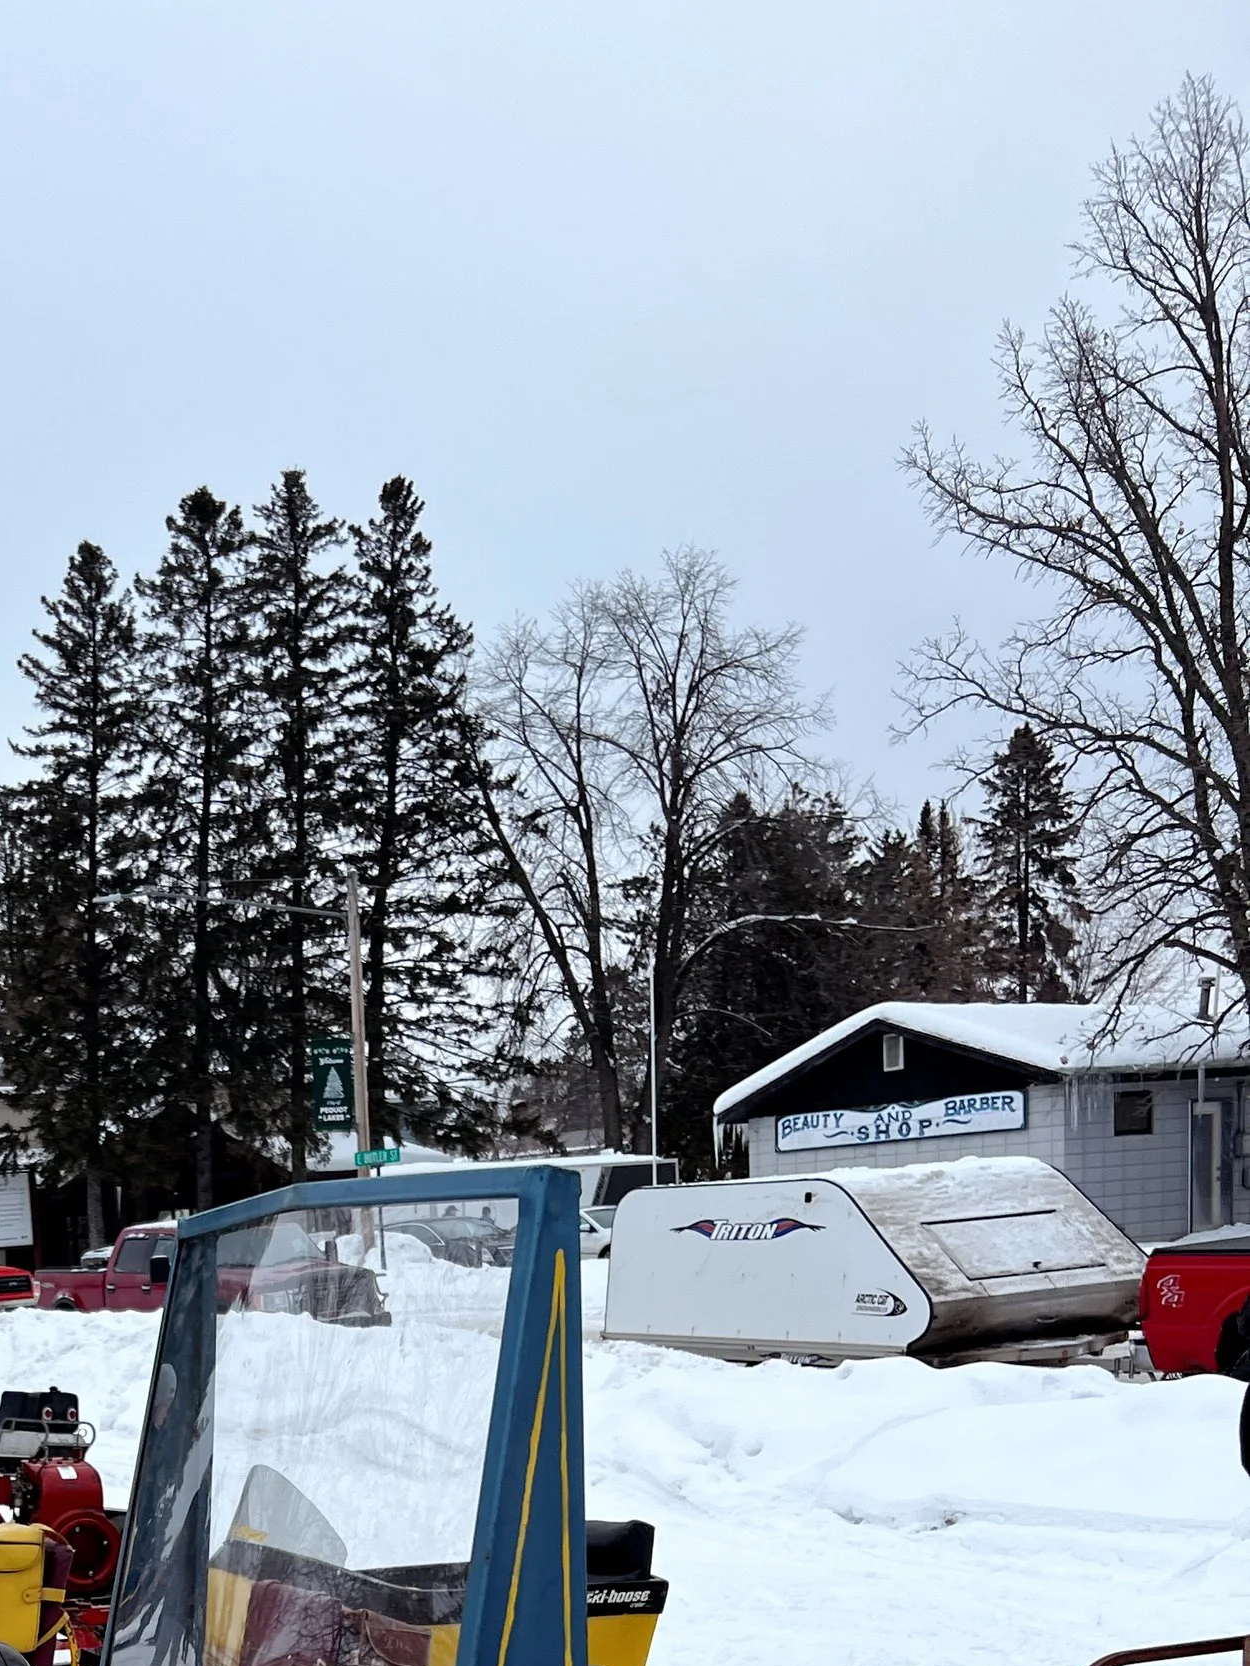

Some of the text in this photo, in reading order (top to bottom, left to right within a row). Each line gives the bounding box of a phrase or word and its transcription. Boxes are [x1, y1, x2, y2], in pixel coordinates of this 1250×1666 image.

[781, 1095, 1016, 1140] BEAUTY AND BARBER
[856, 1118, 933, 1142] SHOP
[710, 1219, 778, 1241] TRITON
